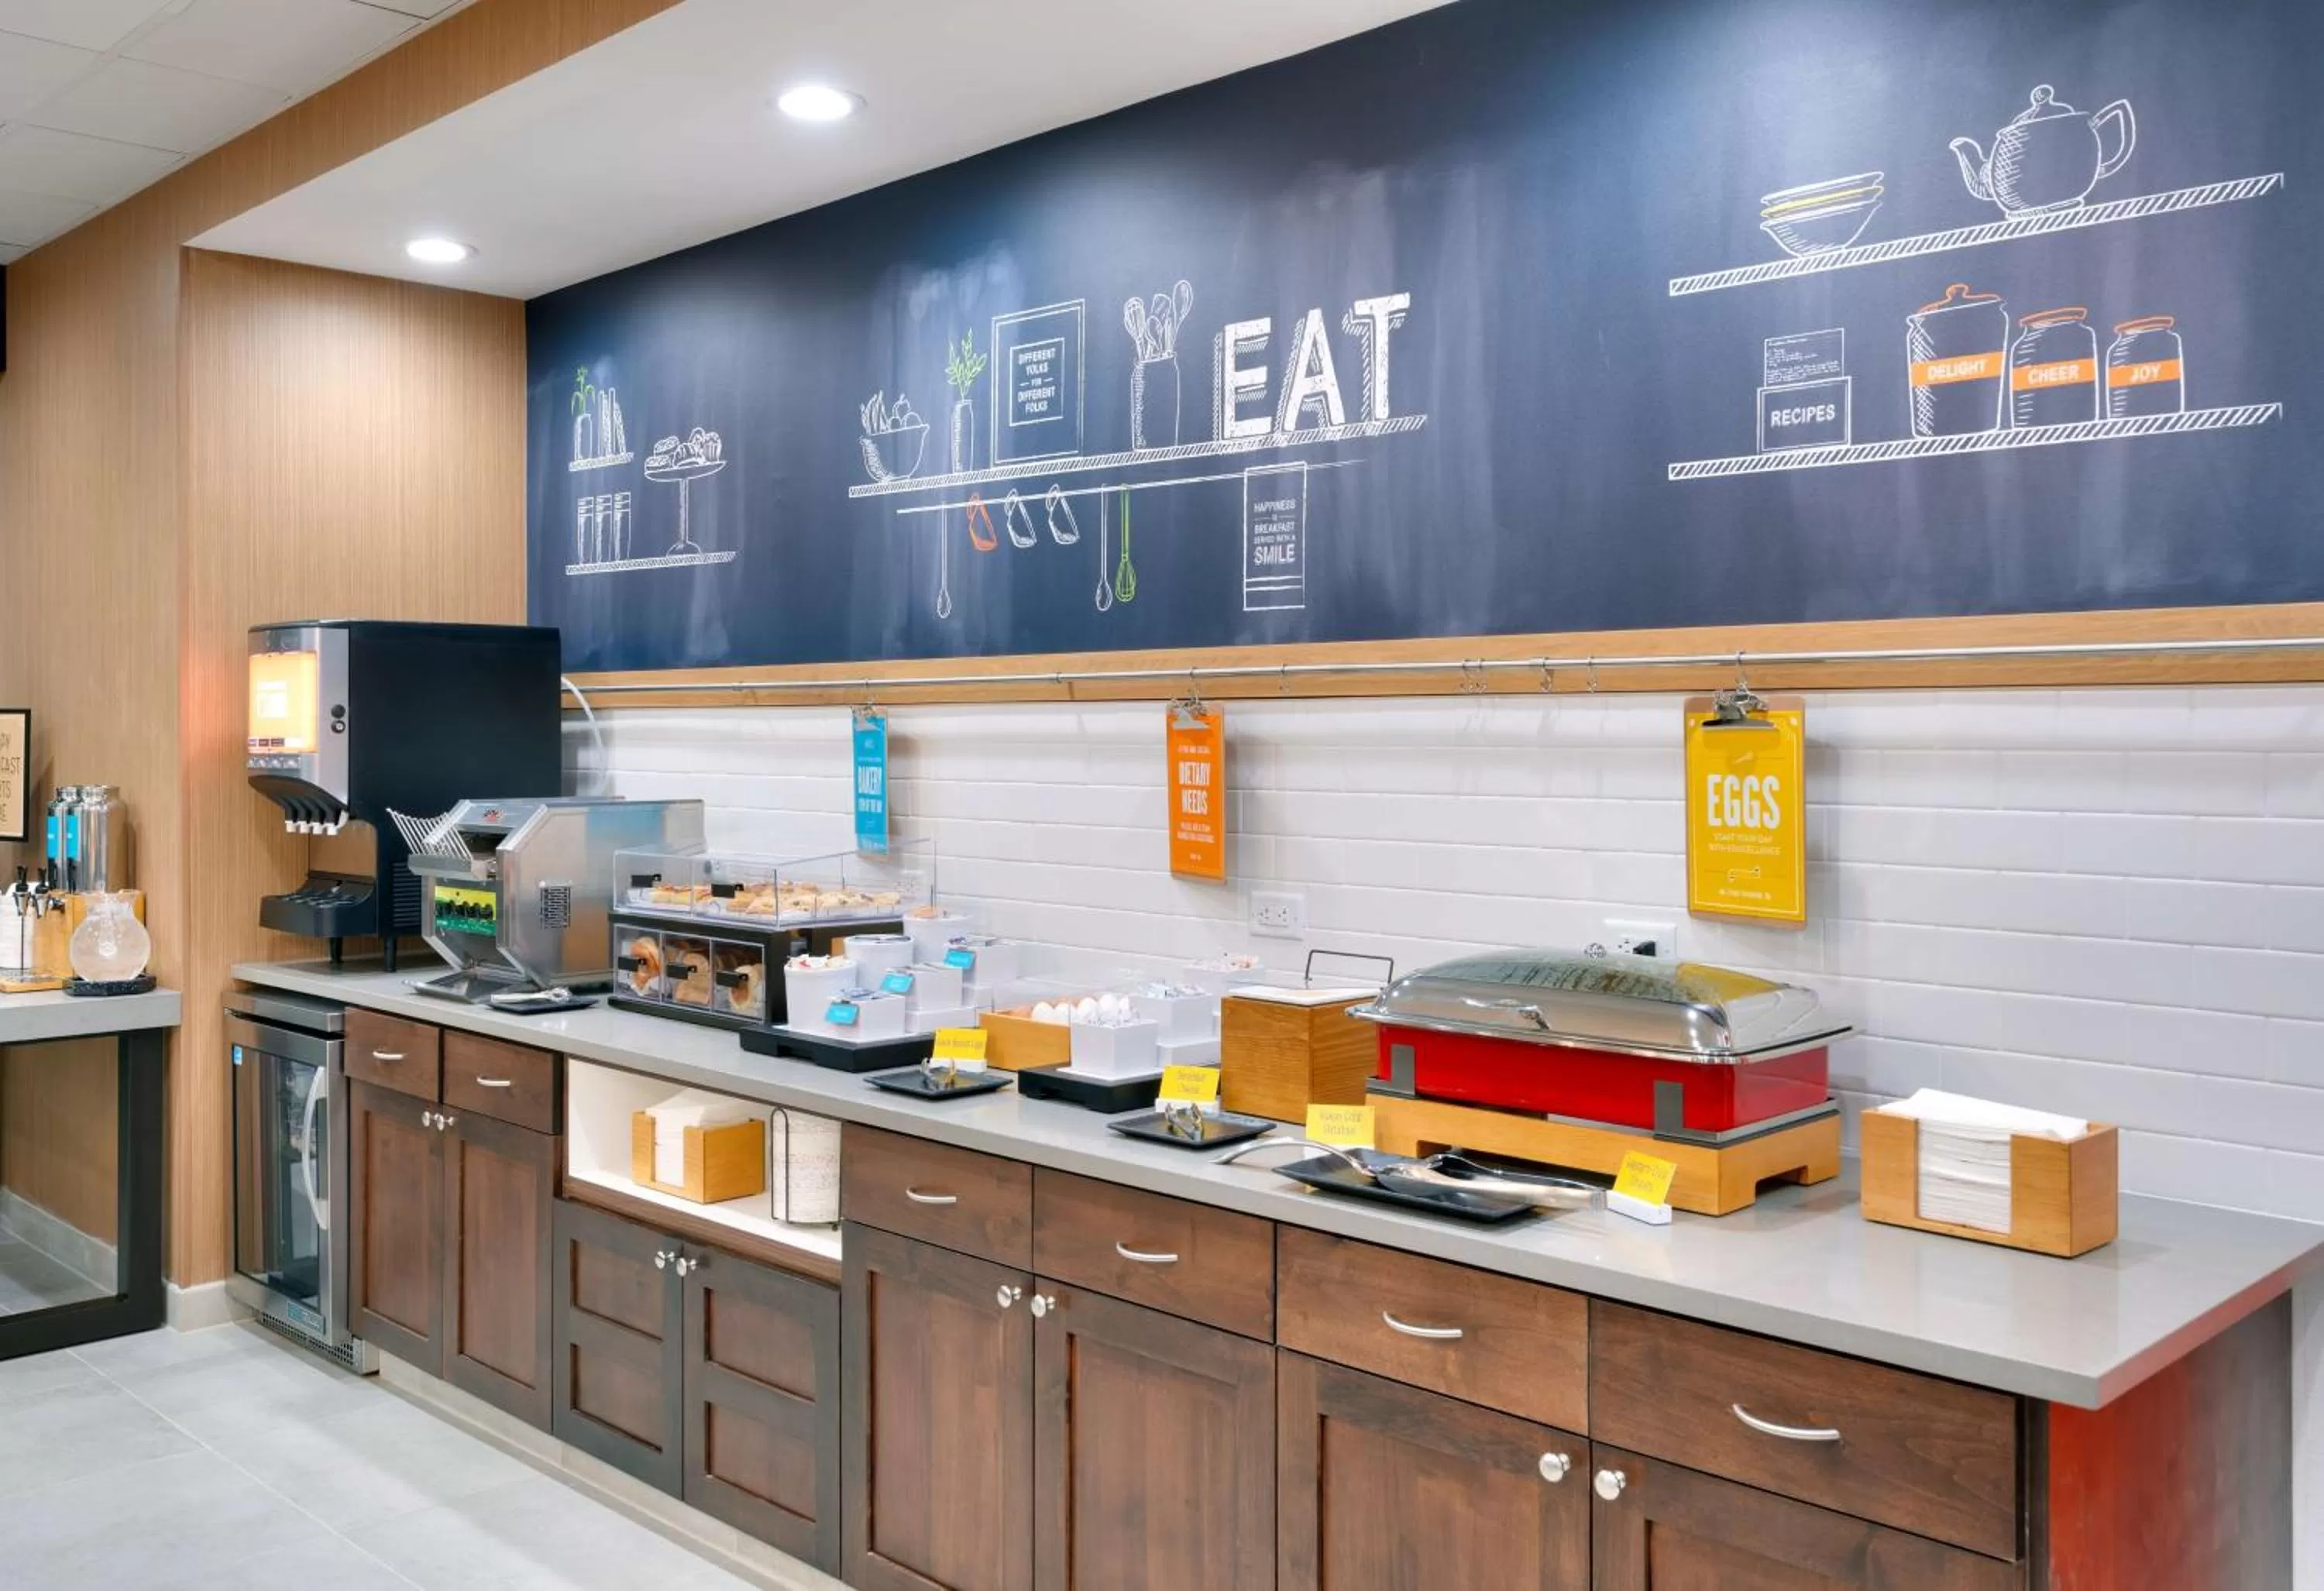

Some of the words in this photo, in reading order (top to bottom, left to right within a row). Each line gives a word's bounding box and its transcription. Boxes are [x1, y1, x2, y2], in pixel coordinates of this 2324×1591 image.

[1018, 348, 1056, 366] DIFFERENT
[1218, 292, 1411, 441] EAT
[1026, 362, 1049, 376] YOLKS
[1927, 359, 1988, 380] DELIGHT
[2027, 365, 2079, 384] CHEER
[2130, 365, 2161, 383] JOY
[1017, 386, 1056, 404] DIFFERENT
[1025, 400, 1048, 415] FOLKS
[1771, 404, 1835, 428] RECIPES
[1253, 498, 1297, 512] HAPPINESS
[1254, 521, 1295, 534] BREAKFAST
[1254, 543, 1296, 565] SMILE
[1178, 761, 1211, 786] DIETARY
[1181, 789, 1208, 815] NEEDS
[1707, 775, 1781, 830] EGGS
